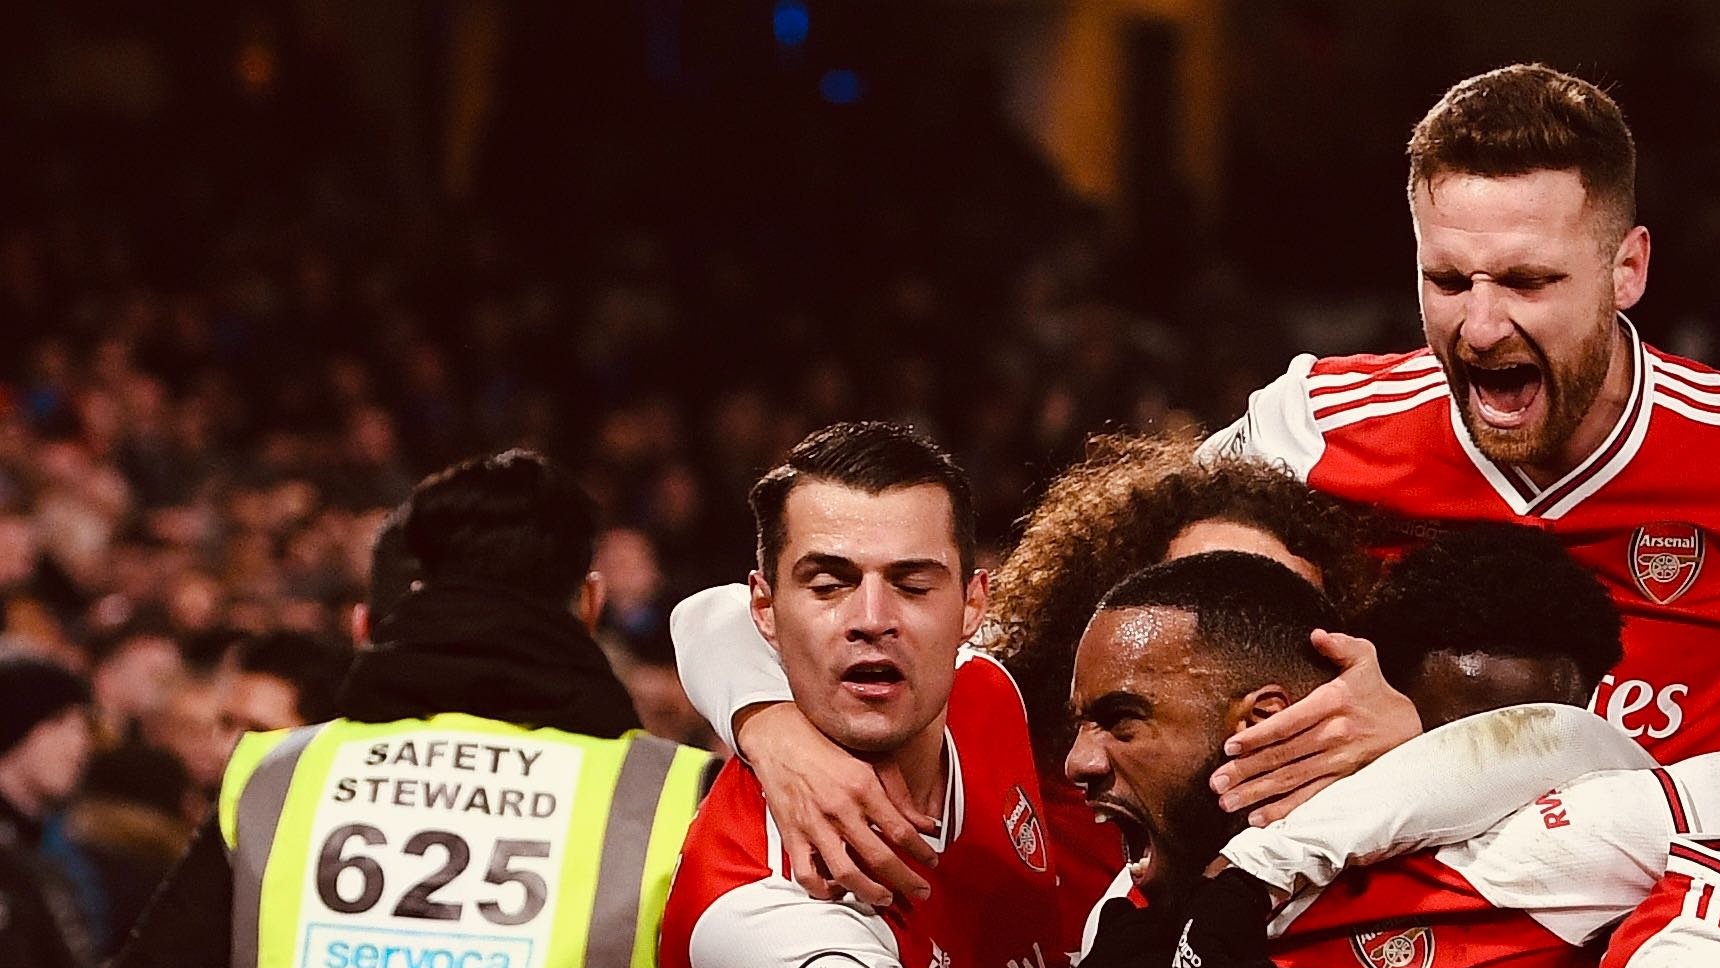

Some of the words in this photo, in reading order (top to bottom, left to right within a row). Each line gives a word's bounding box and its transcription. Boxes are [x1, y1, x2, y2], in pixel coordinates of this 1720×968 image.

[1640, 534, 1694, 548] Arsenal
[364, 740, 544, 778] SAFETY
[333, 776, 558, 820] STEWARD
[314, 822, 553, 926] 625
